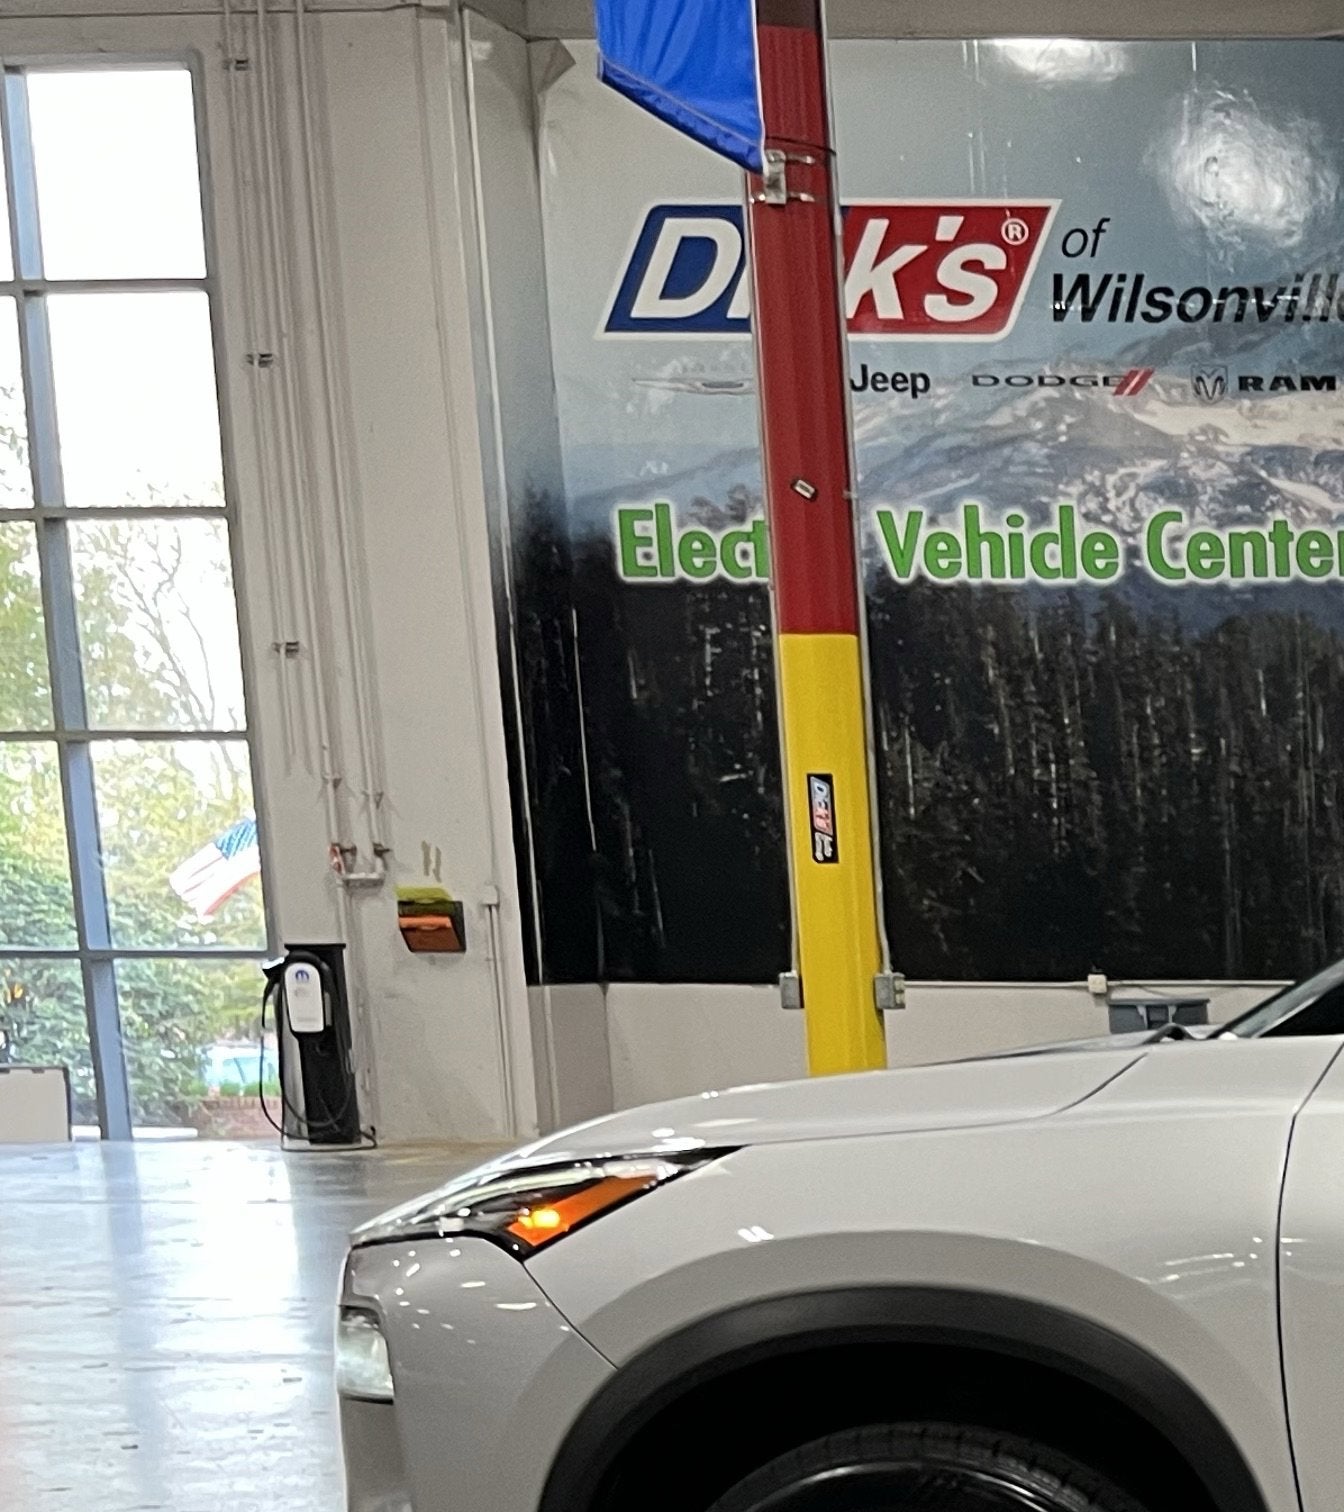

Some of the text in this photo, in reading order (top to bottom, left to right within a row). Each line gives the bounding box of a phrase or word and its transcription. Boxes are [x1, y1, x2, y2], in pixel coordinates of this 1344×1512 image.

[1061, 218, 1110, 258] of
[851, 364, 930, 398] Jeep
[1238, 375, 1337, 391] RAM
[618, 503, 770, 579] Elect
[876, 504, 1119, 579] Vehicle
